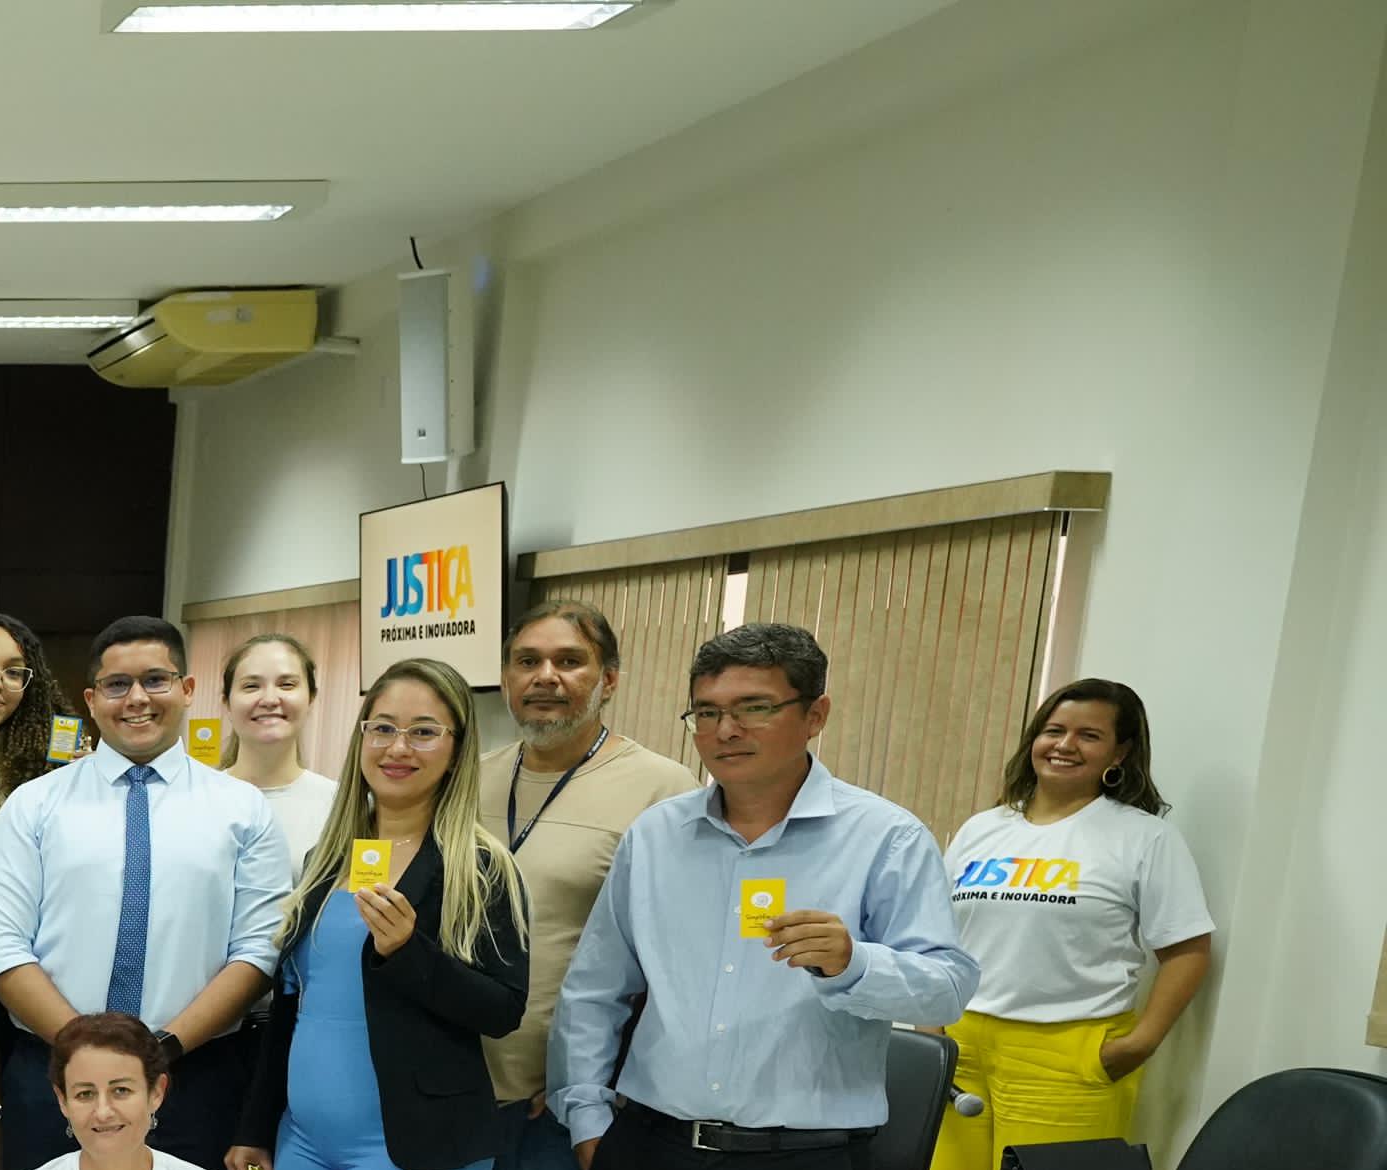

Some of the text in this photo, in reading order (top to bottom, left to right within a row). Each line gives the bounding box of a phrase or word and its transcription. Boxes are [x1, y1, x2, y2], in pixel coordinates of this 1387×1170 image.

[381, 544, 475, 619] JUSTIÇA
[381, 619, 476, 643] PRÓXIMA E INOVADORA
[955, 857, 1080, 892] JUSTIÇA
[991, 892, 999, 900] E
[1001, 892, 1077, 905] INOVADORA
